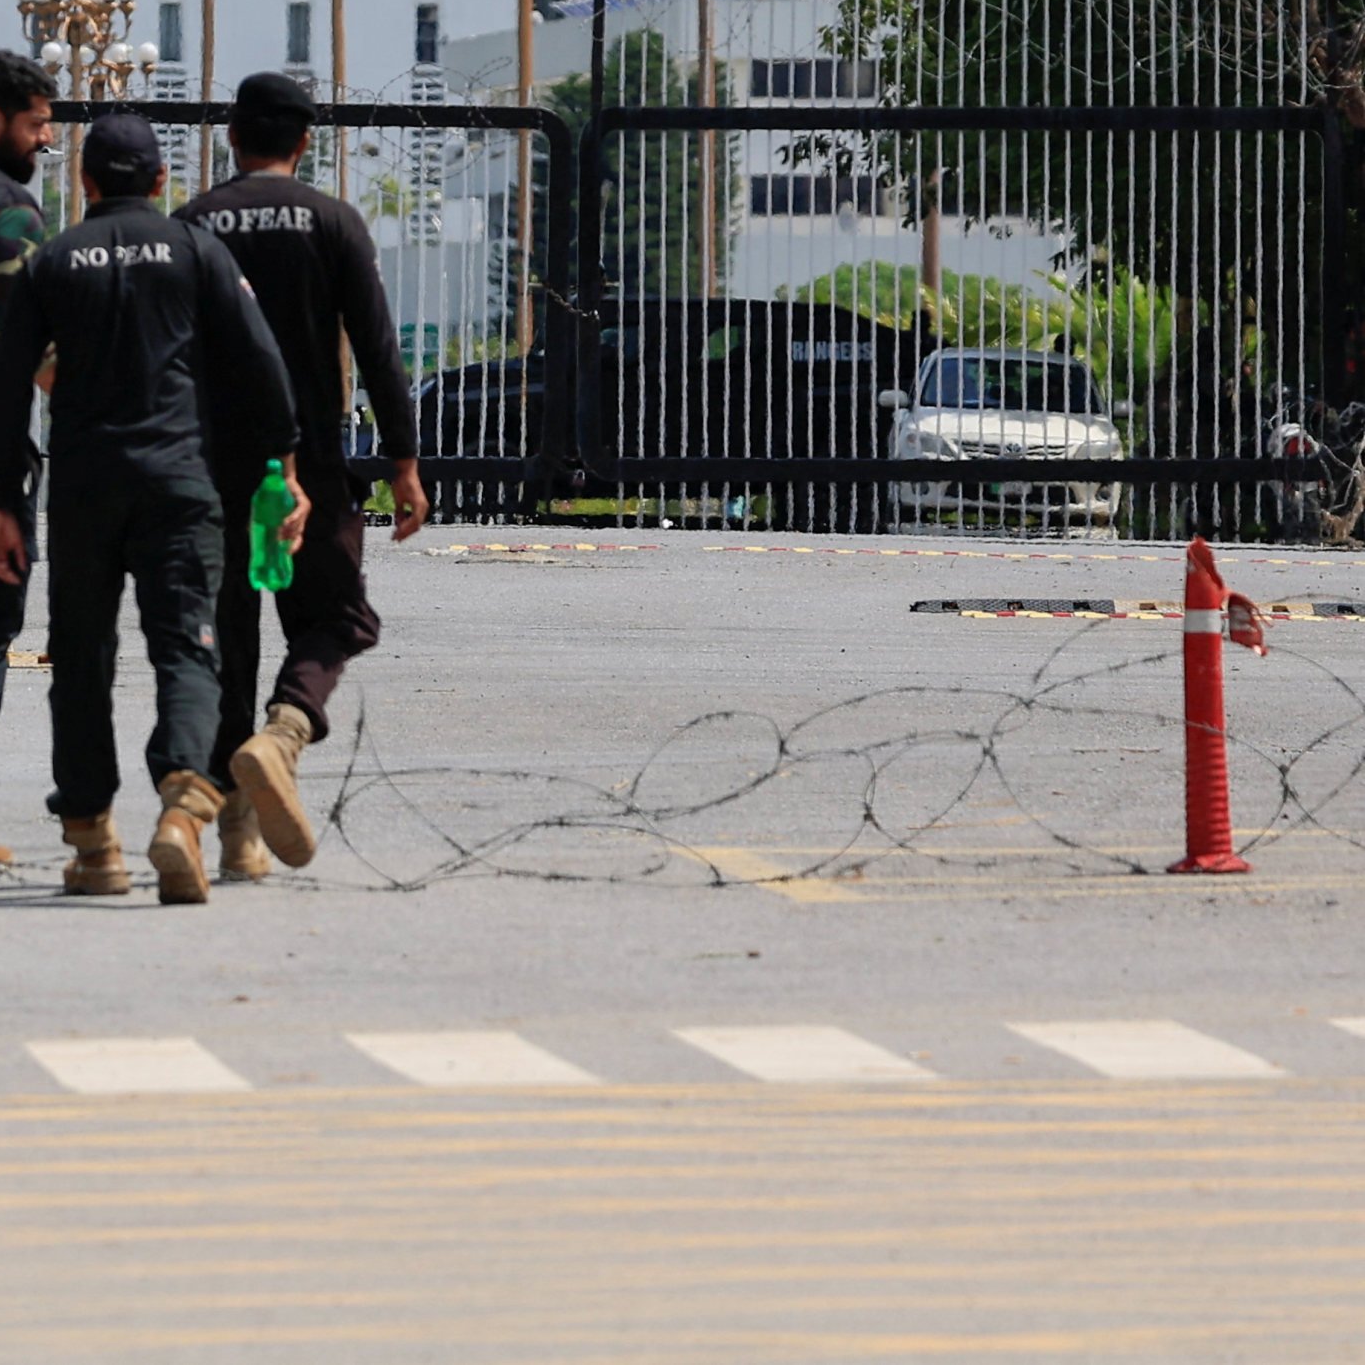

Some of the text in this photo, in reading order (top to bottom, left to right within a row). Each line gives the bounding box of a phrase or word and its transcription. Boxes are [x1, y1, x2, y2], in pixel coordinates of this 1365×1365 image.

[239, 206, 313, 233] FEAR
[70, 246, 109, 269] NO
[792, 341, 874, 361] RANGERS
